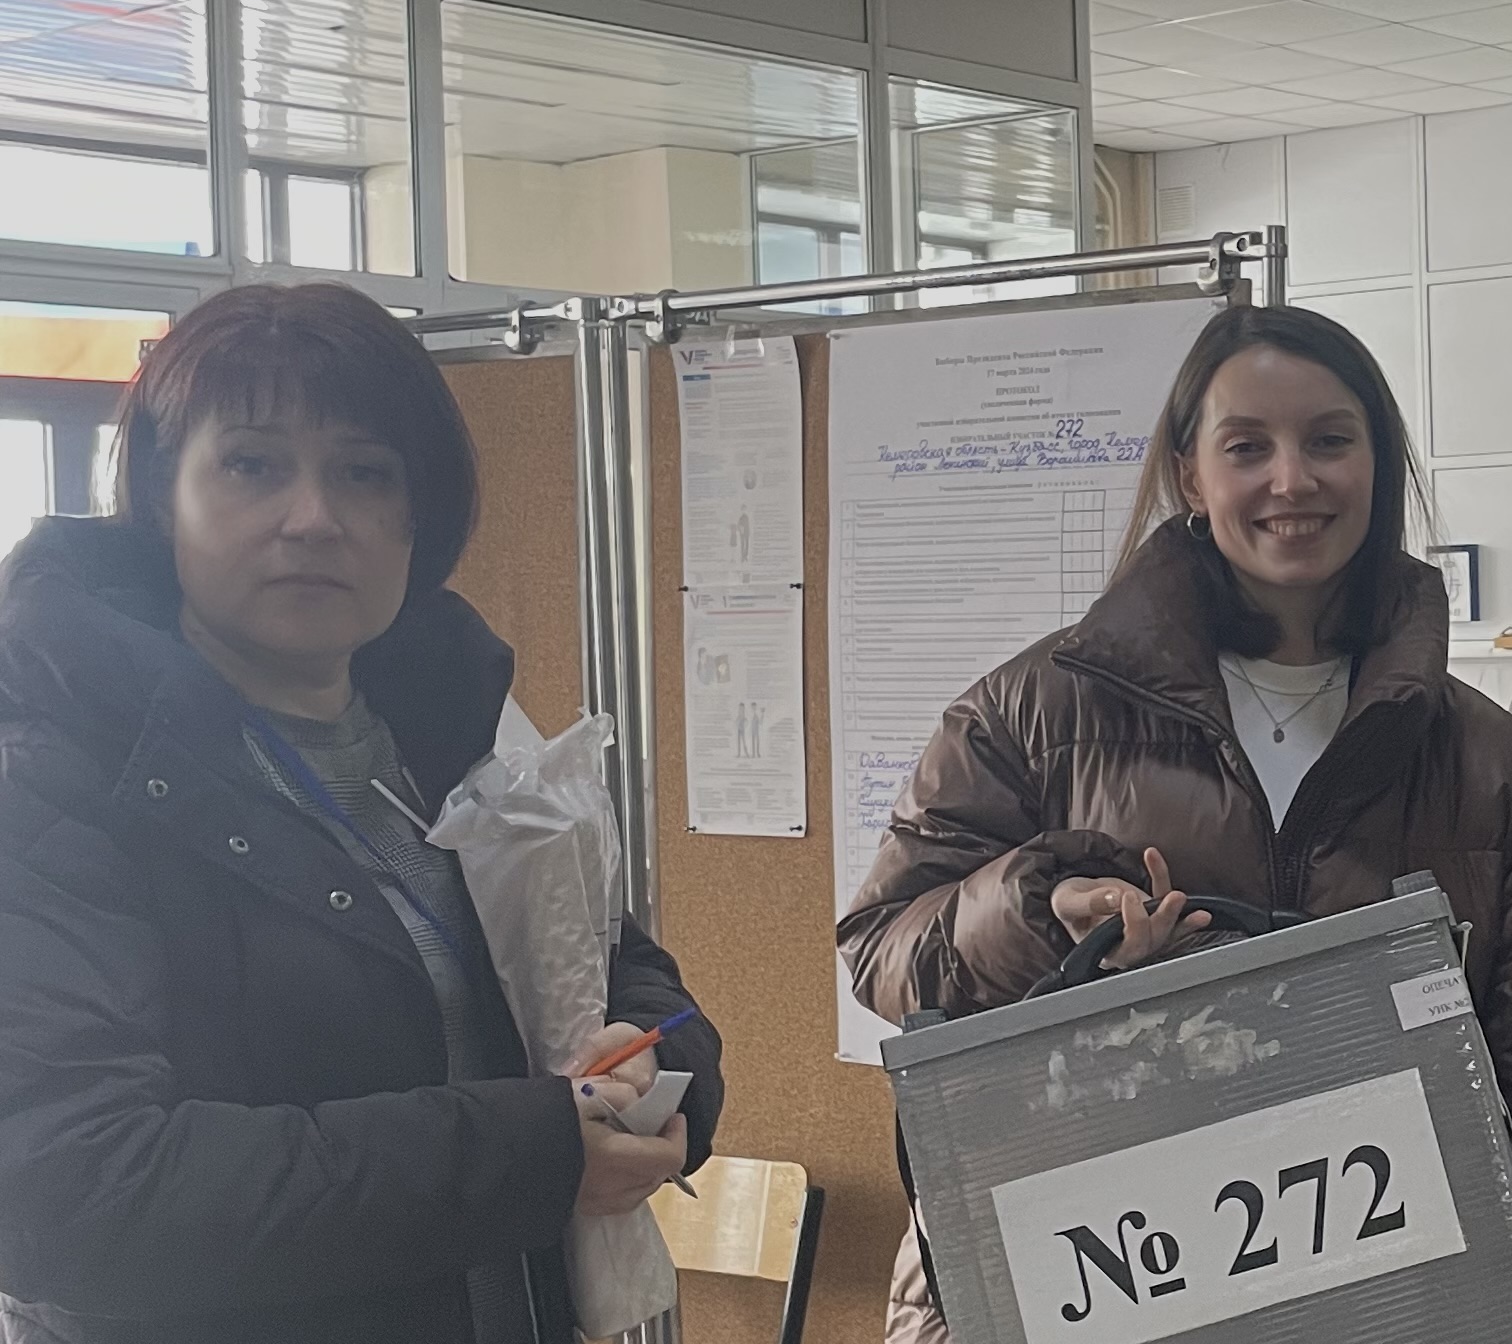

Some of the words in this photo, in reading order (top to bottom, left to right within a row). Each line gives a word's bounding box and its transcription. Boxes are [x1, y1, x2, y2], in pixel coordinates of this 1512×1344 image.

[1055, 418, 1085, 439] 272
[1053, 1210, 1187, 1324] №
[1214, 1144, 1407, 1277] 272
